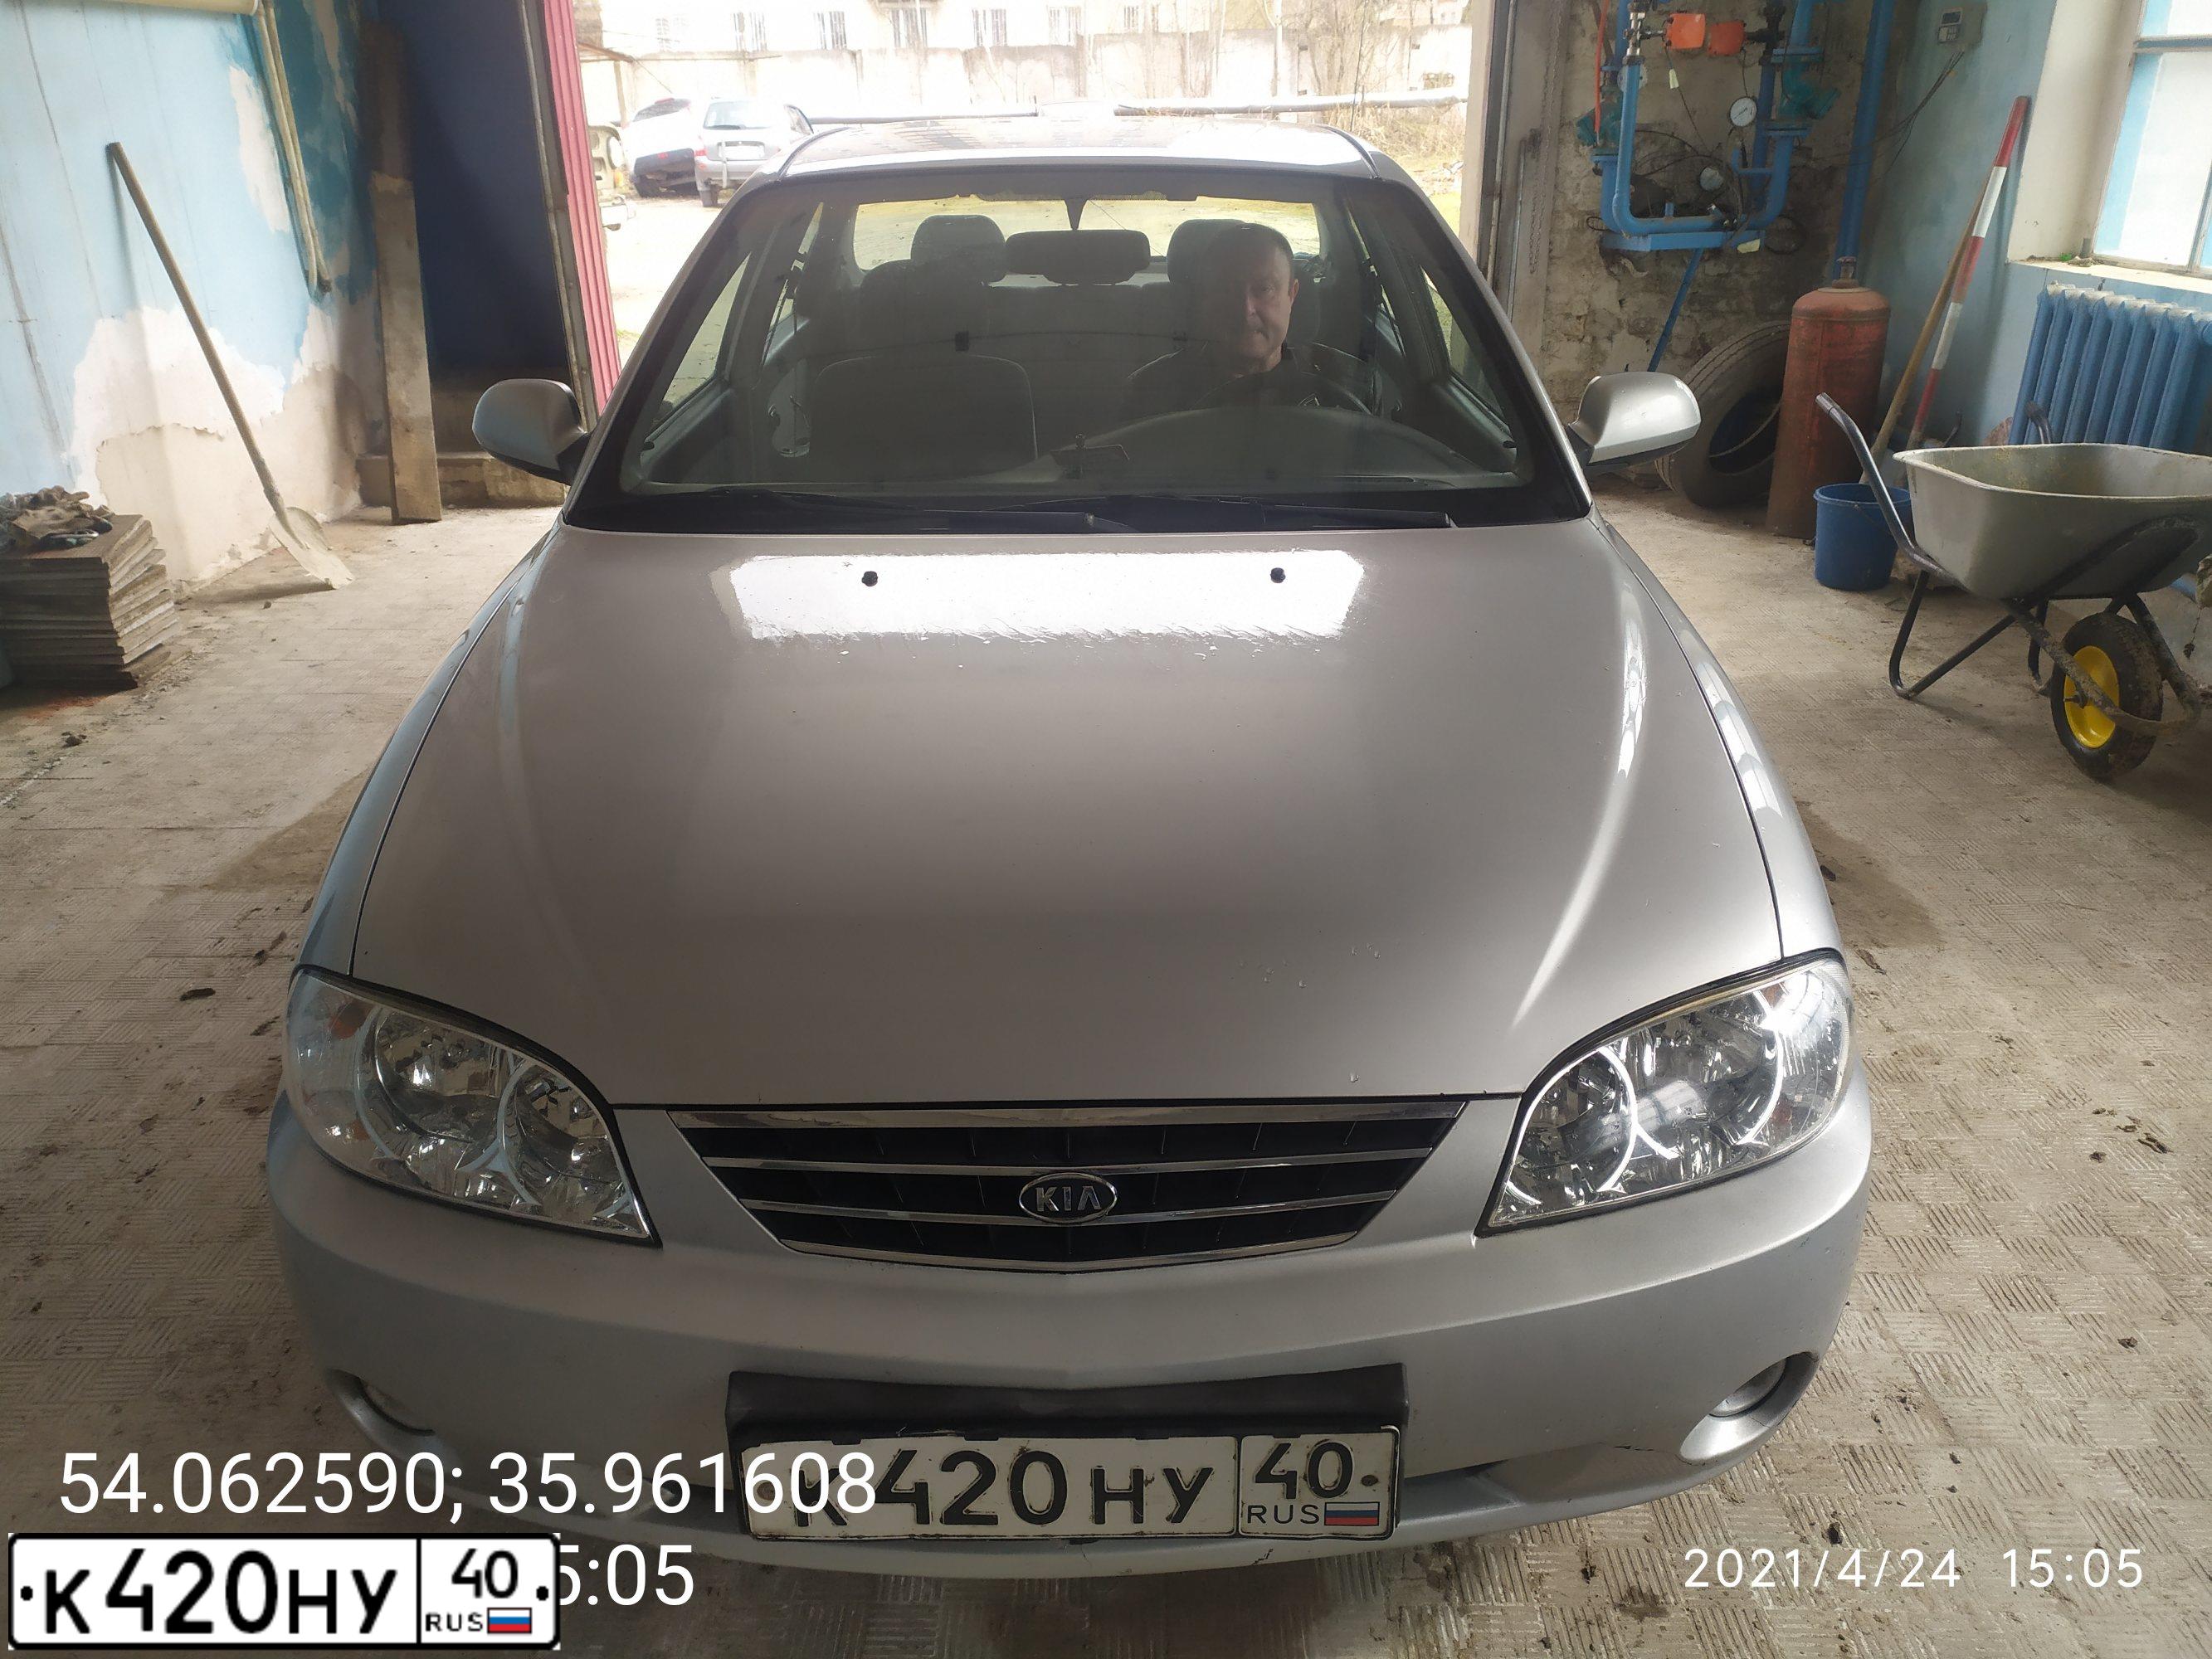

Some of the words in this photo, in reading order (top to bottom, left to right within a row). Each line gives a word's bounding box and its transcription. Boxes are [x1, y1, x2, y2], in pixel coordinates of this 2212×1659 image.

[1035, 1185, 1102, 1212] KIA
[1253, 1438, 1353, 1500] 40
[1247, 1502, 1320, 1525] RUS
